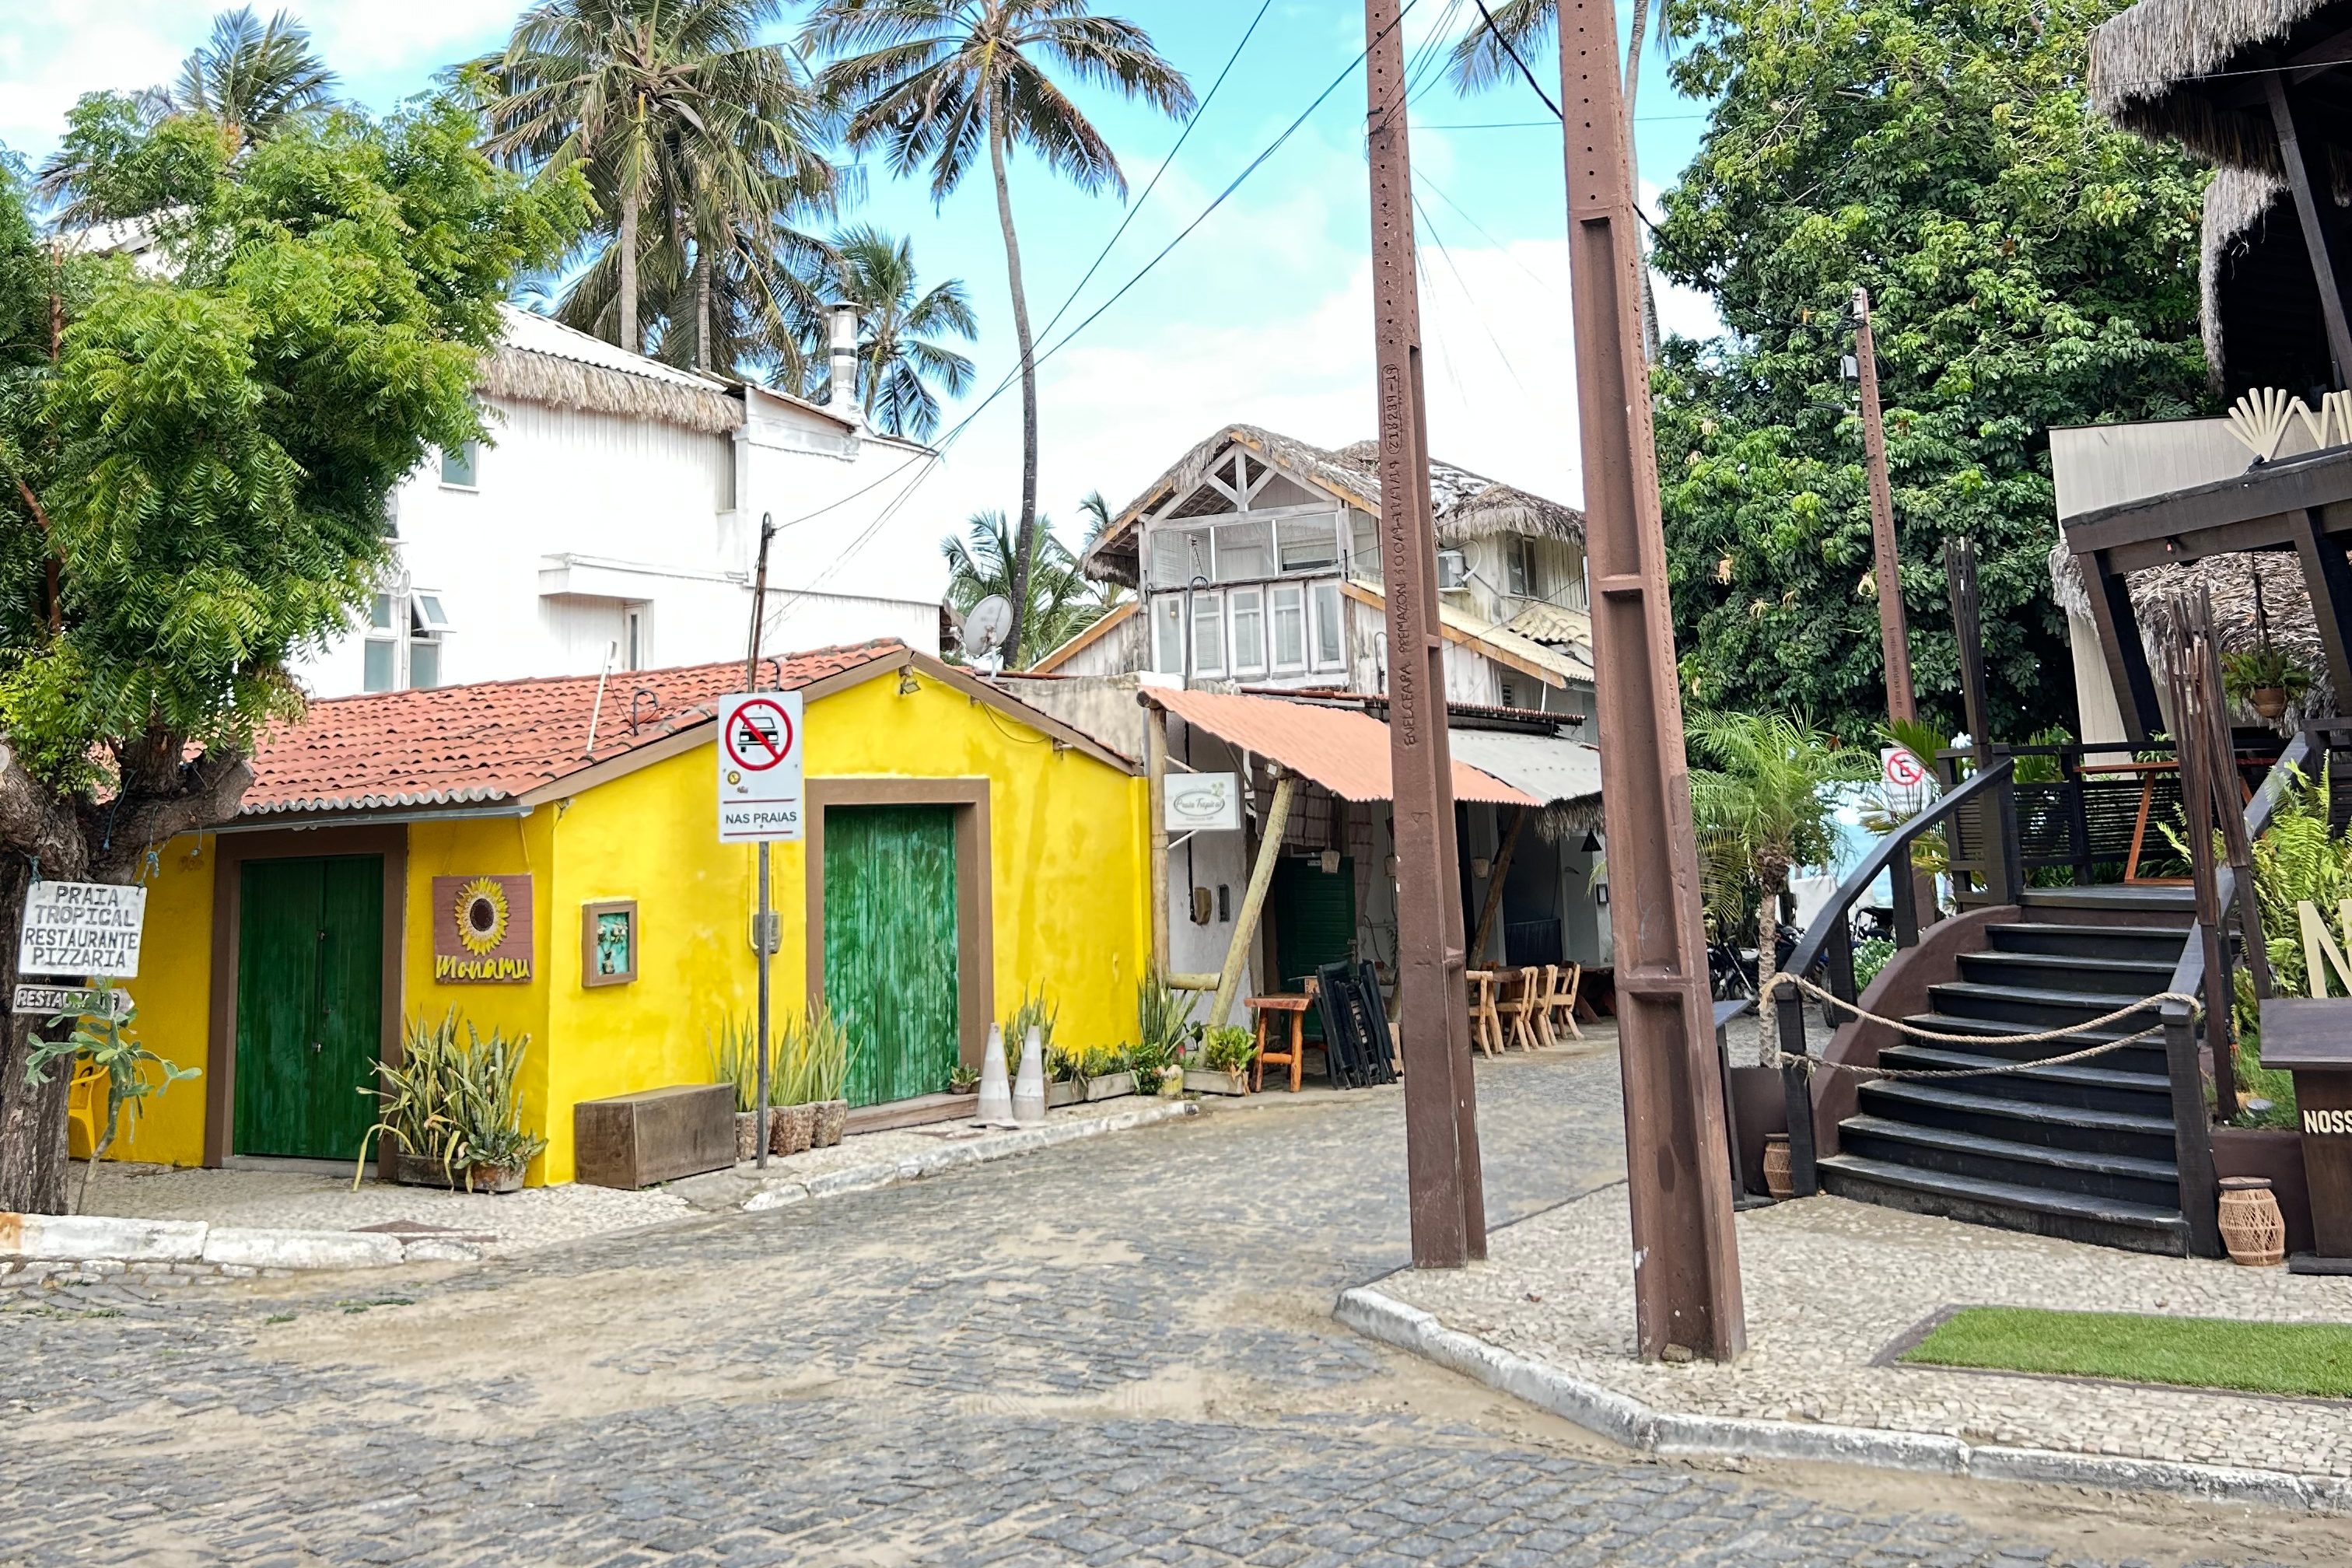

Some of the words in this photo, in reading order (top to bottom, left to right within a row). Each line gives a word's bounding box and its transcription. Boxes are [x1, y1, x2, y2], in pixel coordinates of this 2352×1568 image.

[726, 814, 750, 824] NAS
[754, 811, 797, 823] PRAIAS
[55, 885, 118, 906] PRAIA
[35, 905, 135, 926] TROPICAL
[24, 927, 138, 950] RESTAURANTE
[31, 947, 126, 968] PIZZARIA
